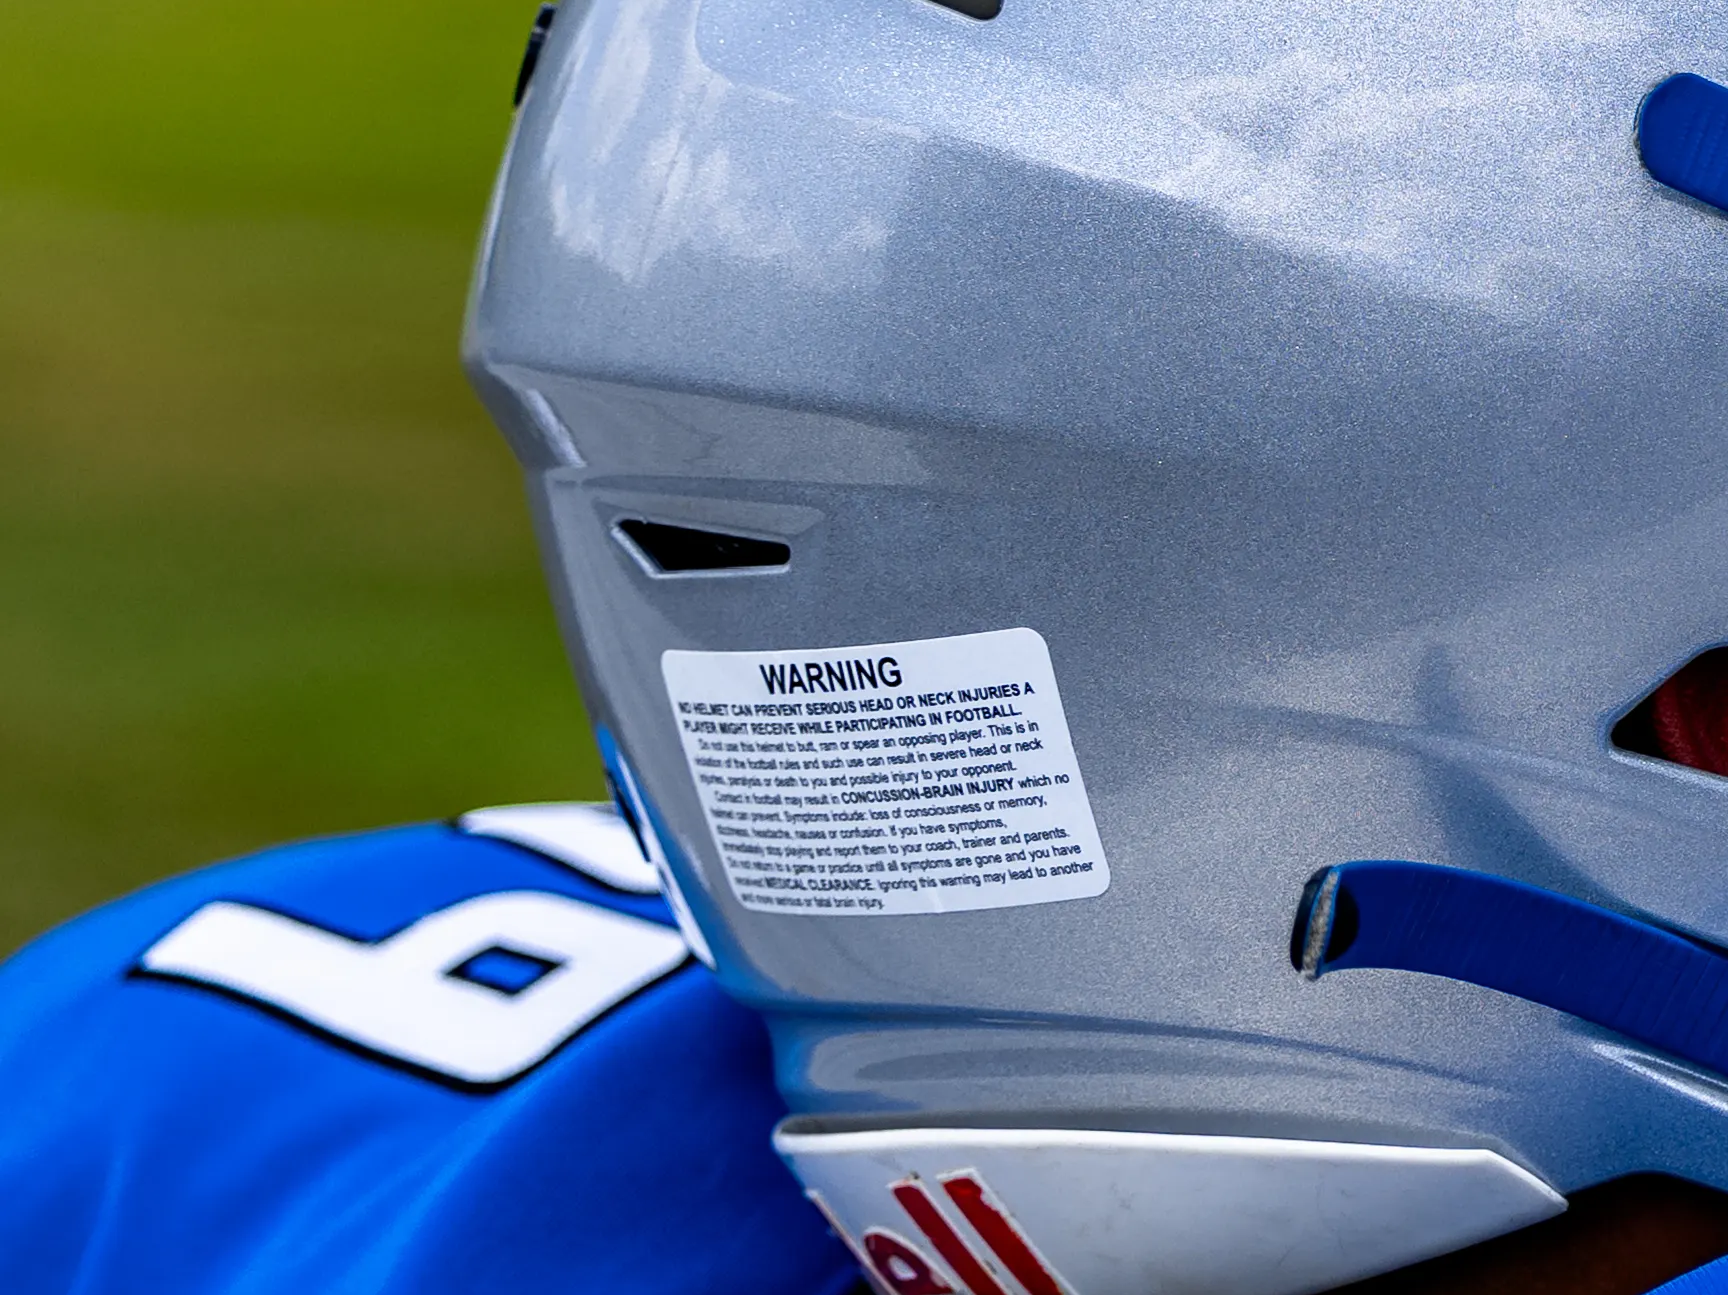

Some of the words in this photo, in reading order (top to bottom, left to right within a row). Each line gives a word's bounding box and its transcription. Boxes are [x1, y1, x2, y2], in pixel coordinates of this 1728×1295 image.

[759, 657, 902, 695] WARNING
[731, 704, 752, 716] CAN
[754, 704, 802, 716] PREVENT
[806, 701, 857, 716] SERIOUS
[859, 698, 893, 712] HEAD
[896, 696, 917, 709] OR
[918, 691, 956, 707] NECK
[958, 684, 1021, 702] INJURIES
[1024, 682, 1035, 695] A
[751, 722, 797, 735] RECEIVE
[798, 721, 834, 734] WHILE
[835, 714, 926, 733] PARTICIPATING
[929, 713, 943, 725] IN
[945, 704, 1022, 723] FOOTBALL.
[840, 741, 850, 750] or
[852, 738, 880, 752] spear
[882, 738, 896, 747] an
[898, 732, 947, 749] opposing
[949, 728, 986, 744] player.
[987, 723, 1013, 737] This
[1014, 722, 1025, 734] is
[1027, 720, 1039, 732] in
[802, 758, 819, 769] and
[821, 757, 844, 769] such
[845, 757, 864, 767] use
[866, 756, 884, 766] can
[886, 752, 916, 764] result
[916, 751, 928, 762] in
[930, 748, 967, 761] severe
[968, 743, 997, 757] head
[1000, 743, 1012, 754] or
[1015, 737, 1043, 752] neck
[811, 777, 828, 789] you
[829, 773, 848, 786] and
[849, 772, 889, 787] possible
[890, 770, 919, 784] injury
[921, 768, 933, 780] to
[935, 767, 958, 781] your
[961, 760, 1017, 777] opponent.
[841, 782, 964, 805] CONCUSSION-BRAIN
[966, 777, 1014, 795] INJURY
[1017, 773, 1052, 789] which
[1054, 773, 1070, 785] no
[868, 808, 890, 820] loss
[891, 807, 902, 819] of
[904, 802, 982, 819] consciousness
[983, 800, 996, 811] or
[998, 795, 1048, 809] memory,
[860, 844, 887, 856] them
[888, 843, 899, 854] to
[900, 843, 922, 857] your
[925, 838, 960, 851] coach,
[961, 835, 997, 849] trainer
[1000, 831, 1021, 845] and
[1023, 826, 1070, 845] parents.
[899, 826, 918, 839] you
[919, 823, 946, 835] have
[948, 818, 1008, 835] symptoms,
[887, 859, 899, 871] all
[900, 857, 953, 873] symptoms
[954, 855, 973, 867] are
[974, 853, 1003, 868] gone
[1005, 849, 1027, 863] and
[1028, 848, 1051, 863] you
[1052, 844, 1082, 857] have
[877, 877, 918, 893] Ignoring
[918, 876, 938, 888] this
[938, 873, 981, 887] warning
[983, 871, 1006, 884] may
[1008, 866, 1034, 881] lead
[1035, 864, 1048, 878] to
[1050, 861, 1094, 877] another
